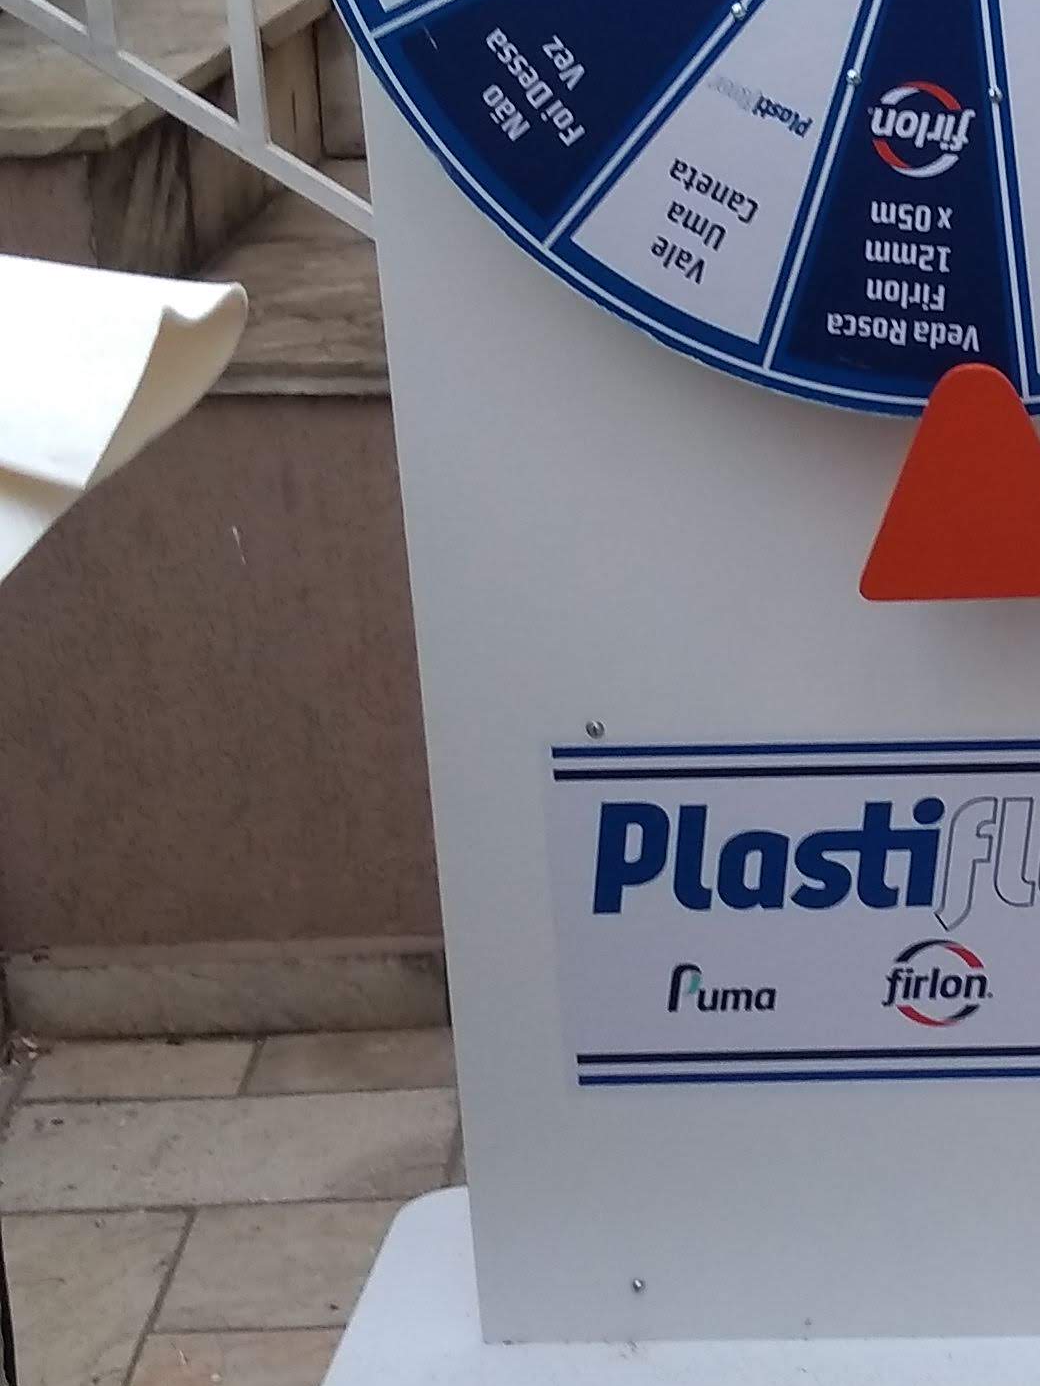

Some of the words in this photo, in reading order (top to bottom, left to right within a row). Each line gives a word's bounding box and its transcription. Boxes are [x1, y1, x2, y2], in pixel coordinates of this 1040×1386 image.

[485, 27, 554, 110] Dessa
[542, 34, 585, 91] Vez
[482, 84, 531, 142] Não
[540, 99, 586, 147] Foi
[669, 158, 759, 224] Caneta
[666, 201, 726, 252] Uma
[870, 200, 932, 233] 05m
[937, 206, 953, 230] x
[650, 235, 705, 285] Vale
[865, 239, 952, 273] 12mm
[866, 278, 946, 312] Firlon
[827, 312, 907, 346] Rosca
[913, 320, 980, 353] Veda
[667, 963, 776, 1013] Puma
